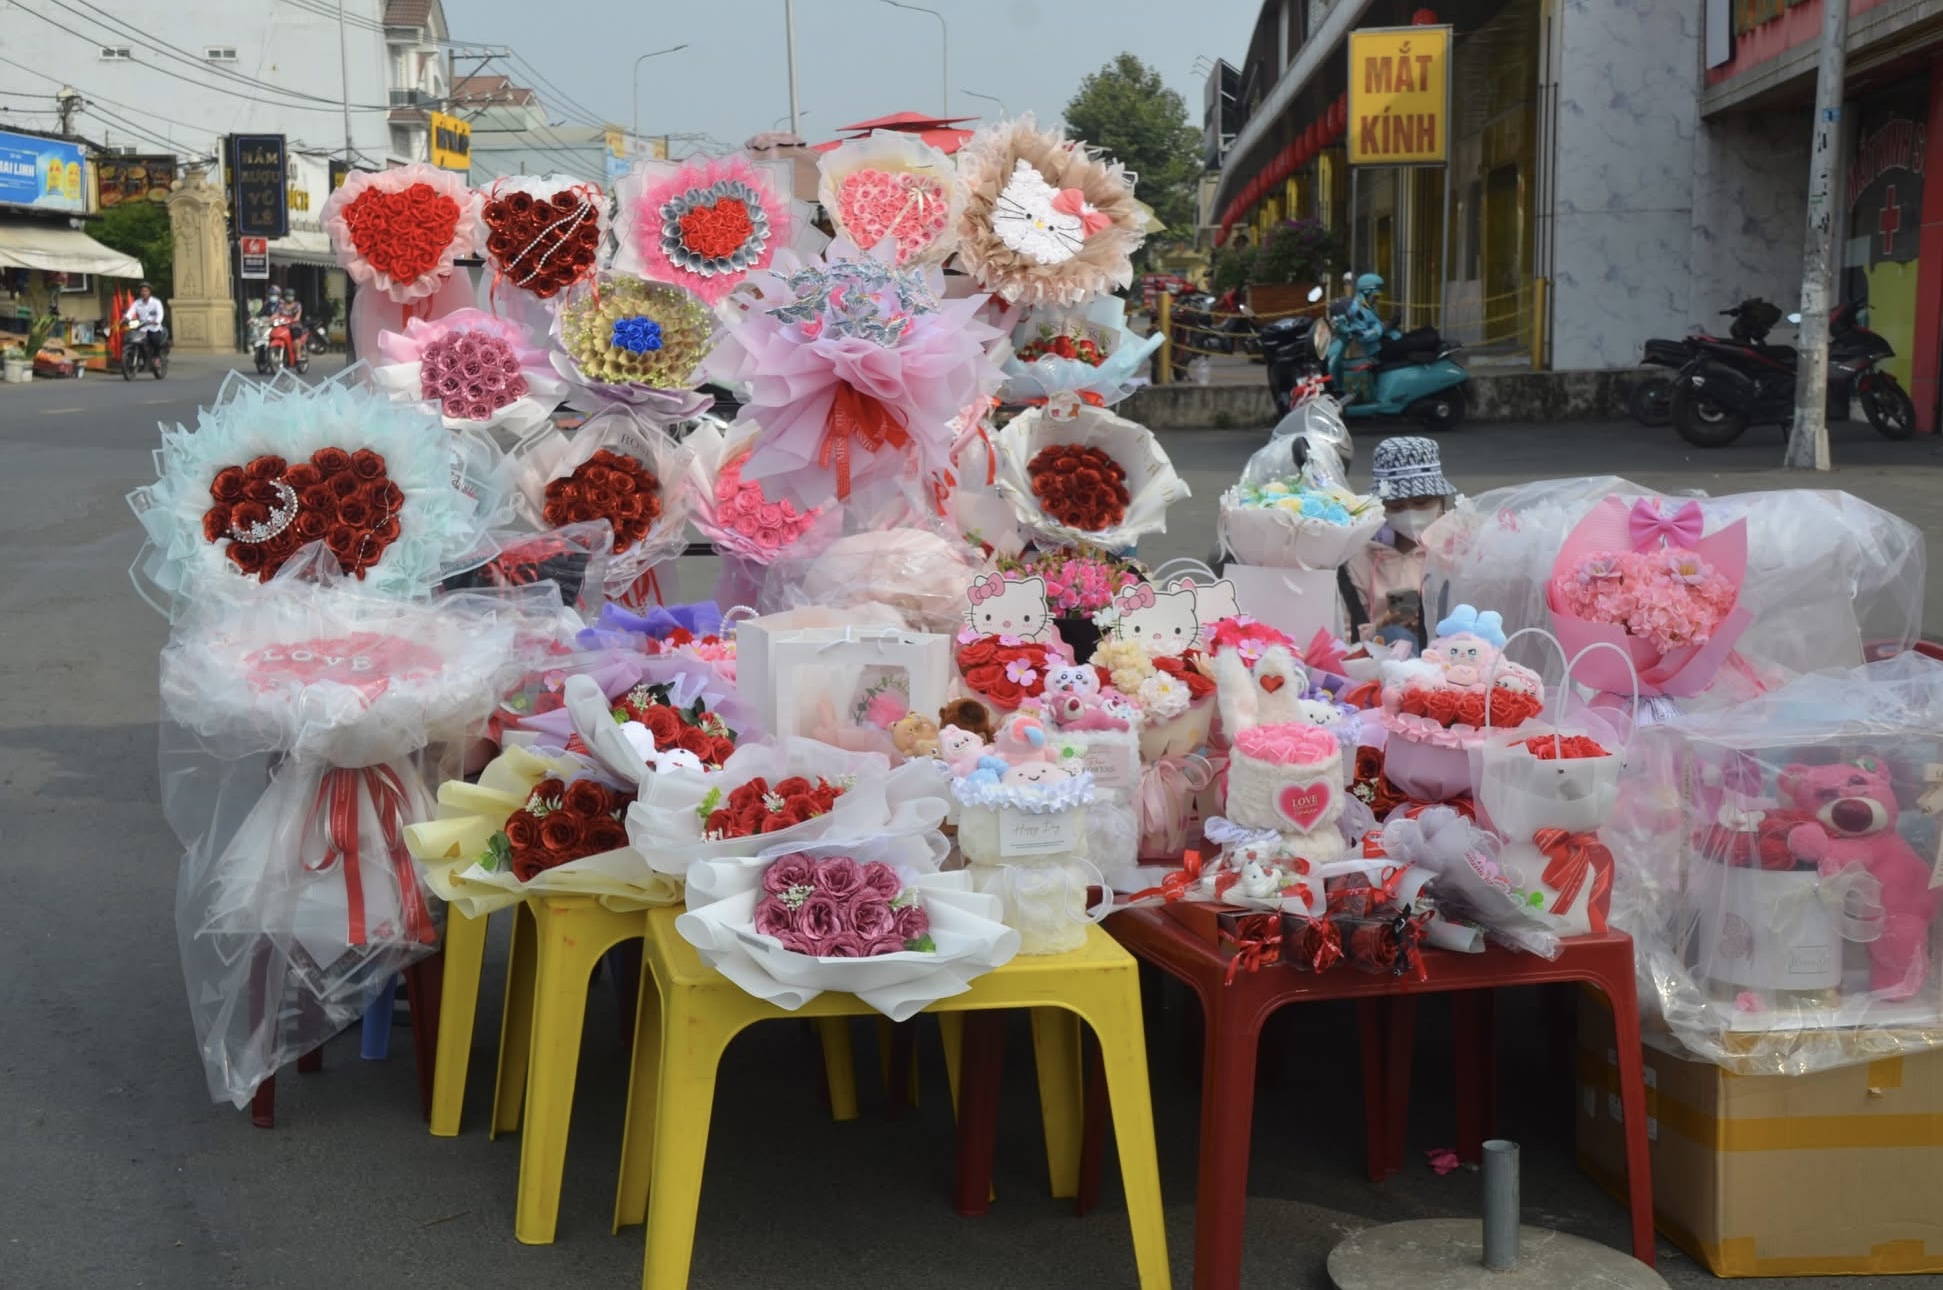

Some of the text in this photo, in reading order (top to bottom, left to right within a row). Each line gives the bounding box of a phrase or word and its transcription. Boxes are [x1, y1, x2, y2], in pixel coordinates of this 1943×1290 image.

[1364, 40, 1433, 94] MẮT
[1360, 105, 1436, 155] KÍNH
[262, 649, 373, 671] LOVE
[1292, 794, 1318, 809] LOVE
